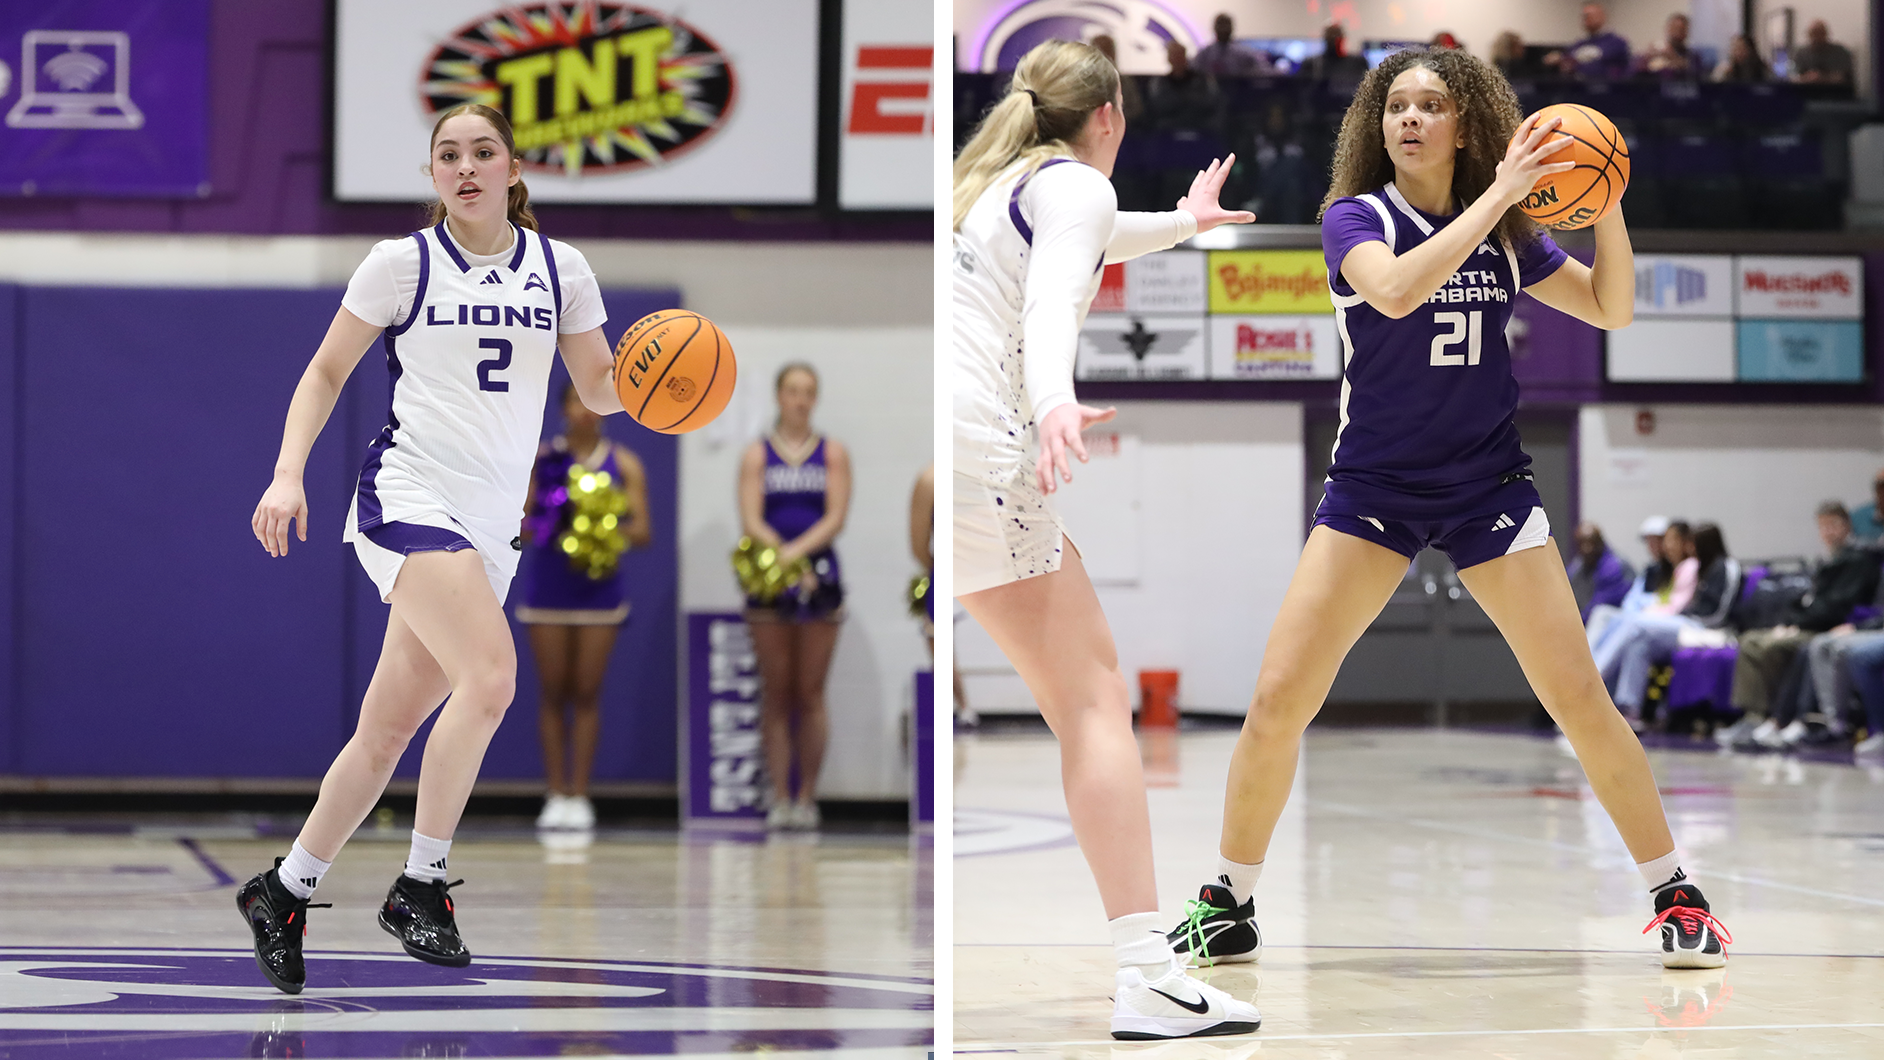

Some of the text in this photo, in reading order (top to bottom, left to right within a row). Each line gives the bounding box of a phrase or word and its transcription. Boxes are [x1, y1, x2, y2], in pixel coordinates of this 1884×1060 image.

[495, 25, 674, 130] TNT
[849, 44, 934, 135] E
[1516, 185, 1559, 210] NCA
[1218, 263, 1328, 301] Bojangle
[1423, 286, 1508, 304] ABAMA
[1444, 270, 1497, 286] RTH
[426, 304, 553, 331] LIONS
[1430, 310, 1483, 367] 21
[476, 337, 513, 393] 2
[628, 338, 662, 389] EVO
